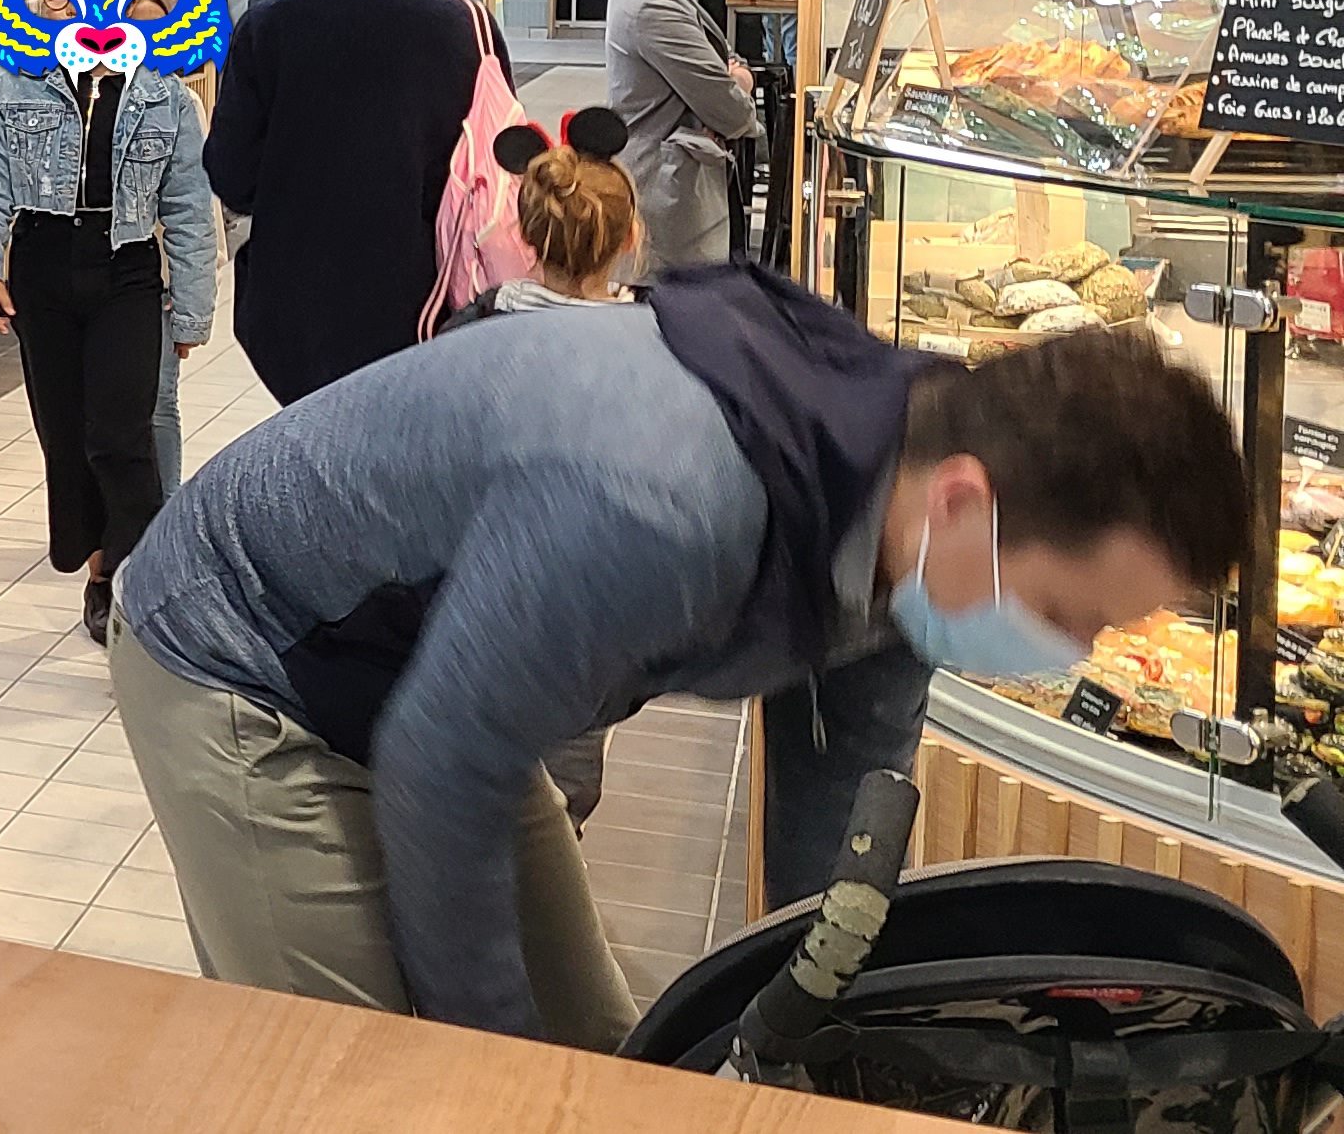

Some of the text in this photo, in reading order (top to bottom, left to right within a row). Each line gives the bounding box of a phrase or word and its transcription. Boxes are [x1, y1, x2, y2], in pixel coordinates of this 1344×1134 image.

[1232, 16, 1291, 43] Planche
[1296, 25, 1311, 45] de
[1227, 43, 1289, 66] Amuses
[1221, 69, 1279, 90] Terrine
[1285, 74, 1301, 93] de
[1218, 93, 1247, 117] Foie
[1254, 99, 1293, 120] Gras
